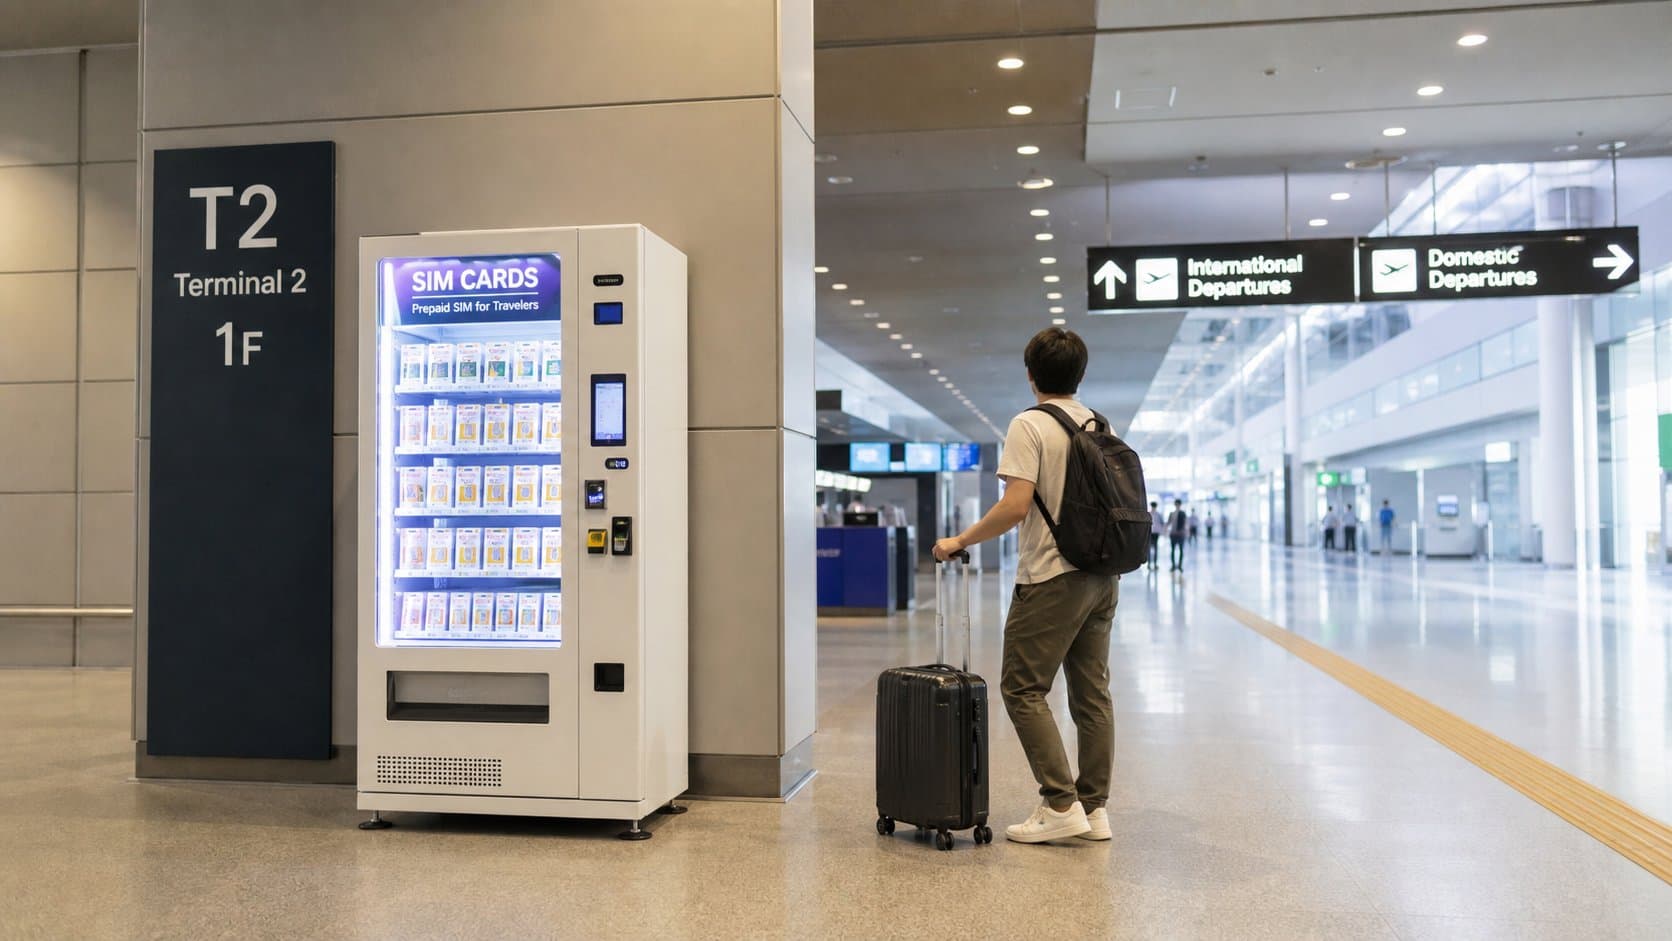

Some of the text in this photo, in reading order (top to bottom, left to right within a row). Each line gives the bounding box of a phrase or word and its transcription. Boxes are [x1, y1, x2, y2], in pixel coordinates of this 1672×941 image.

[189, 184, 277, 250] T2
[1188, 254, 1303, 276] International
[1428, 248, 1521, 268] Domestic
[173, 268, 307, 297] Terminal 2
[412, 267, 539, 292] SIM CARDS
[1188, 278, 1292, 300] Departures
[1428, 270, 1538, 292] Departures
[412, 299, 539, 316] Prepaid SIM for Travelers
[216, 321, 263, 366] 1F
